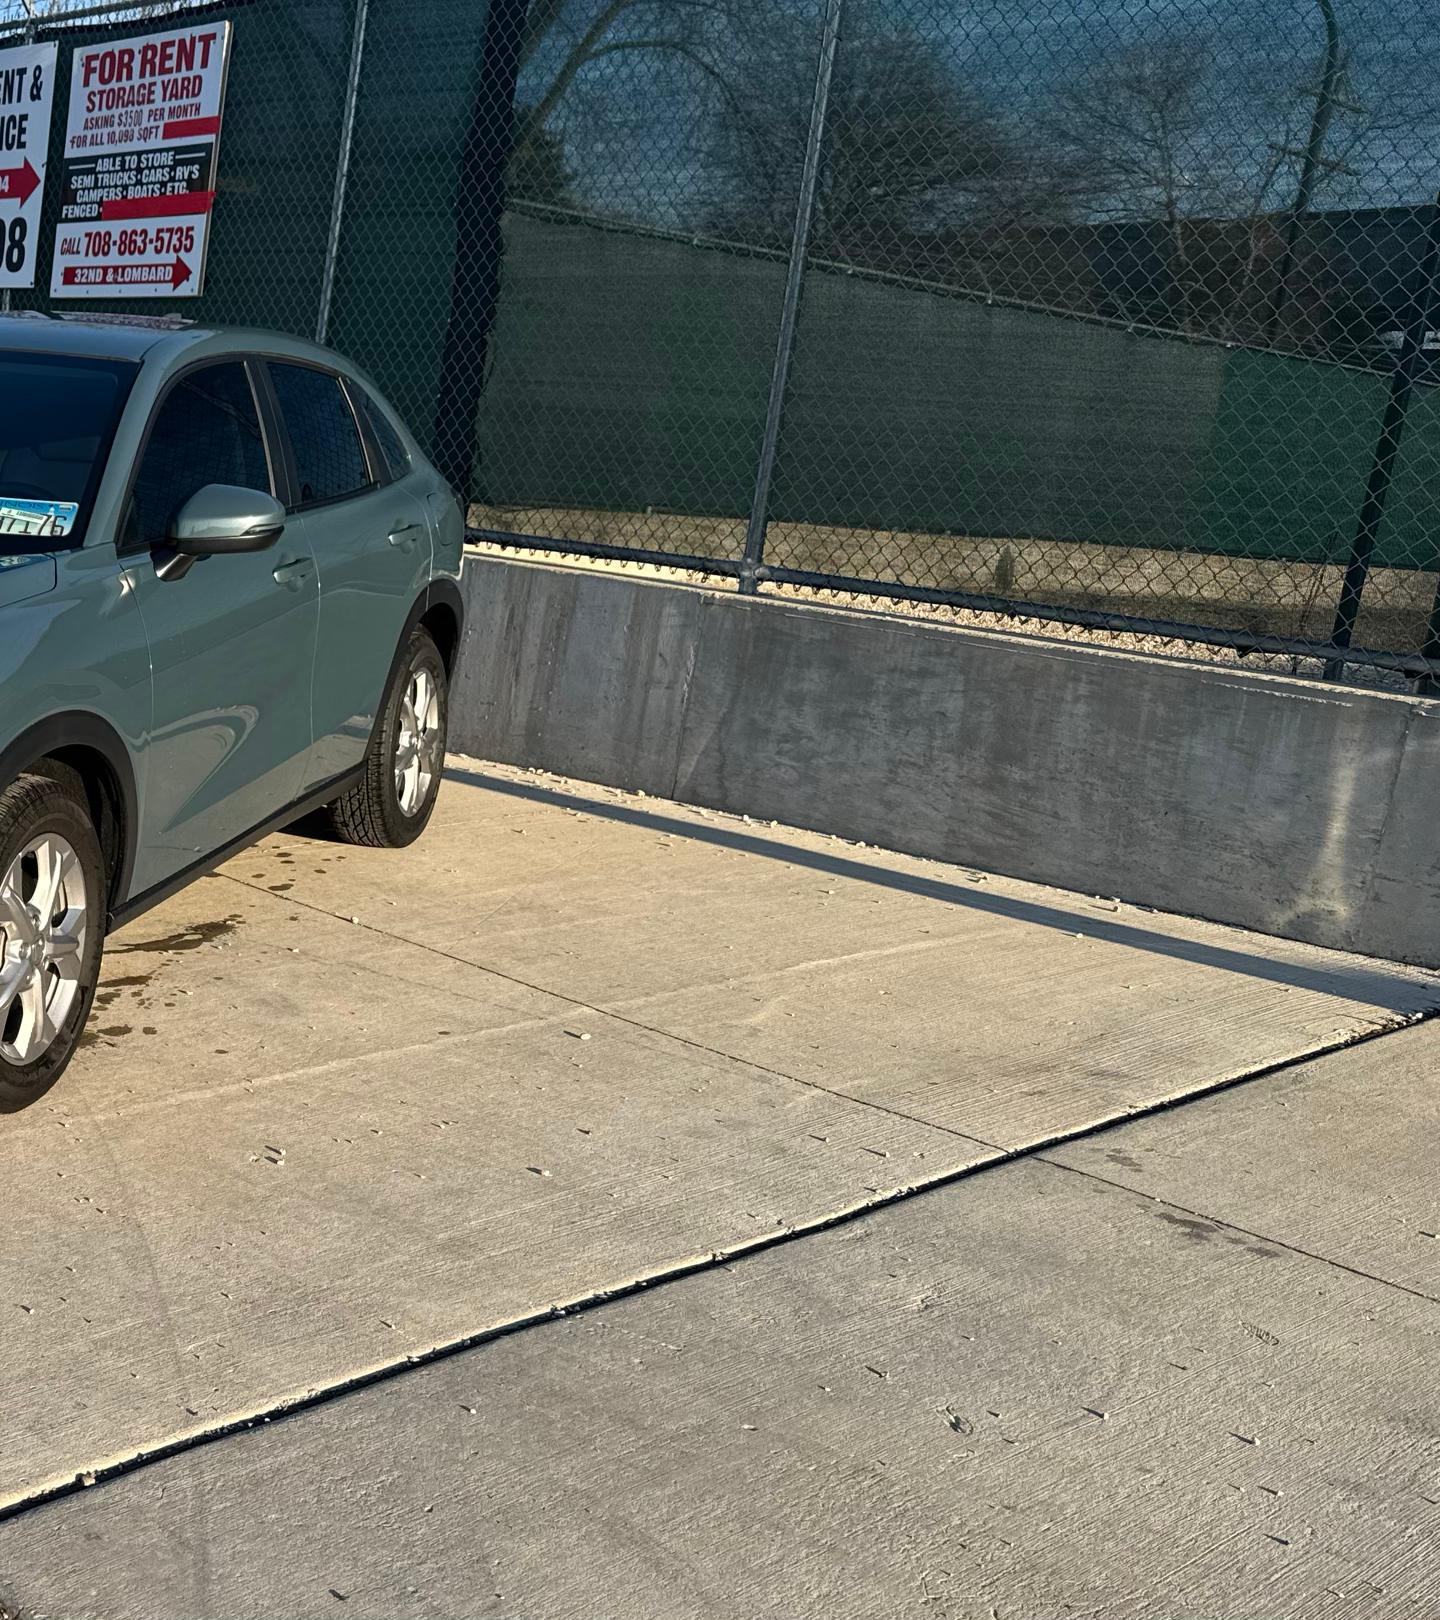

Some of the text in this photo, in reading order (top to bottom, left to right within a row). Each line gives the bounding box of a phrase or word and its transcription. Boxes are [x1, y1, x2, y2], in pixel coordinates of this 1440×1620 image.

[82, 33, 216, 88] FOR RENT
[29, 64, 43, 102] &
[86, 74, 203, 113] STORAGE YARD
[83, 102, 201, 131] ASKING $3500 PER MONTH
[70, 135, 88, 149] FOR
[89, 133, 105, 147] ALL
[136, 125, 160, 143] SQFT
[96, 151, 175, 172] ABLE TO STORE
[70, 165, 200, 189] SEMI TRUCKS CARS RV'S
[76, 181, 189, 203] CAMPERS BOATS ETC.
[62, 204, 98, 219] FENCED
[60, 226, 195, 258] CALL 708-863-5735
[74, 265, 173, 283] 32ND & LOMBARD
